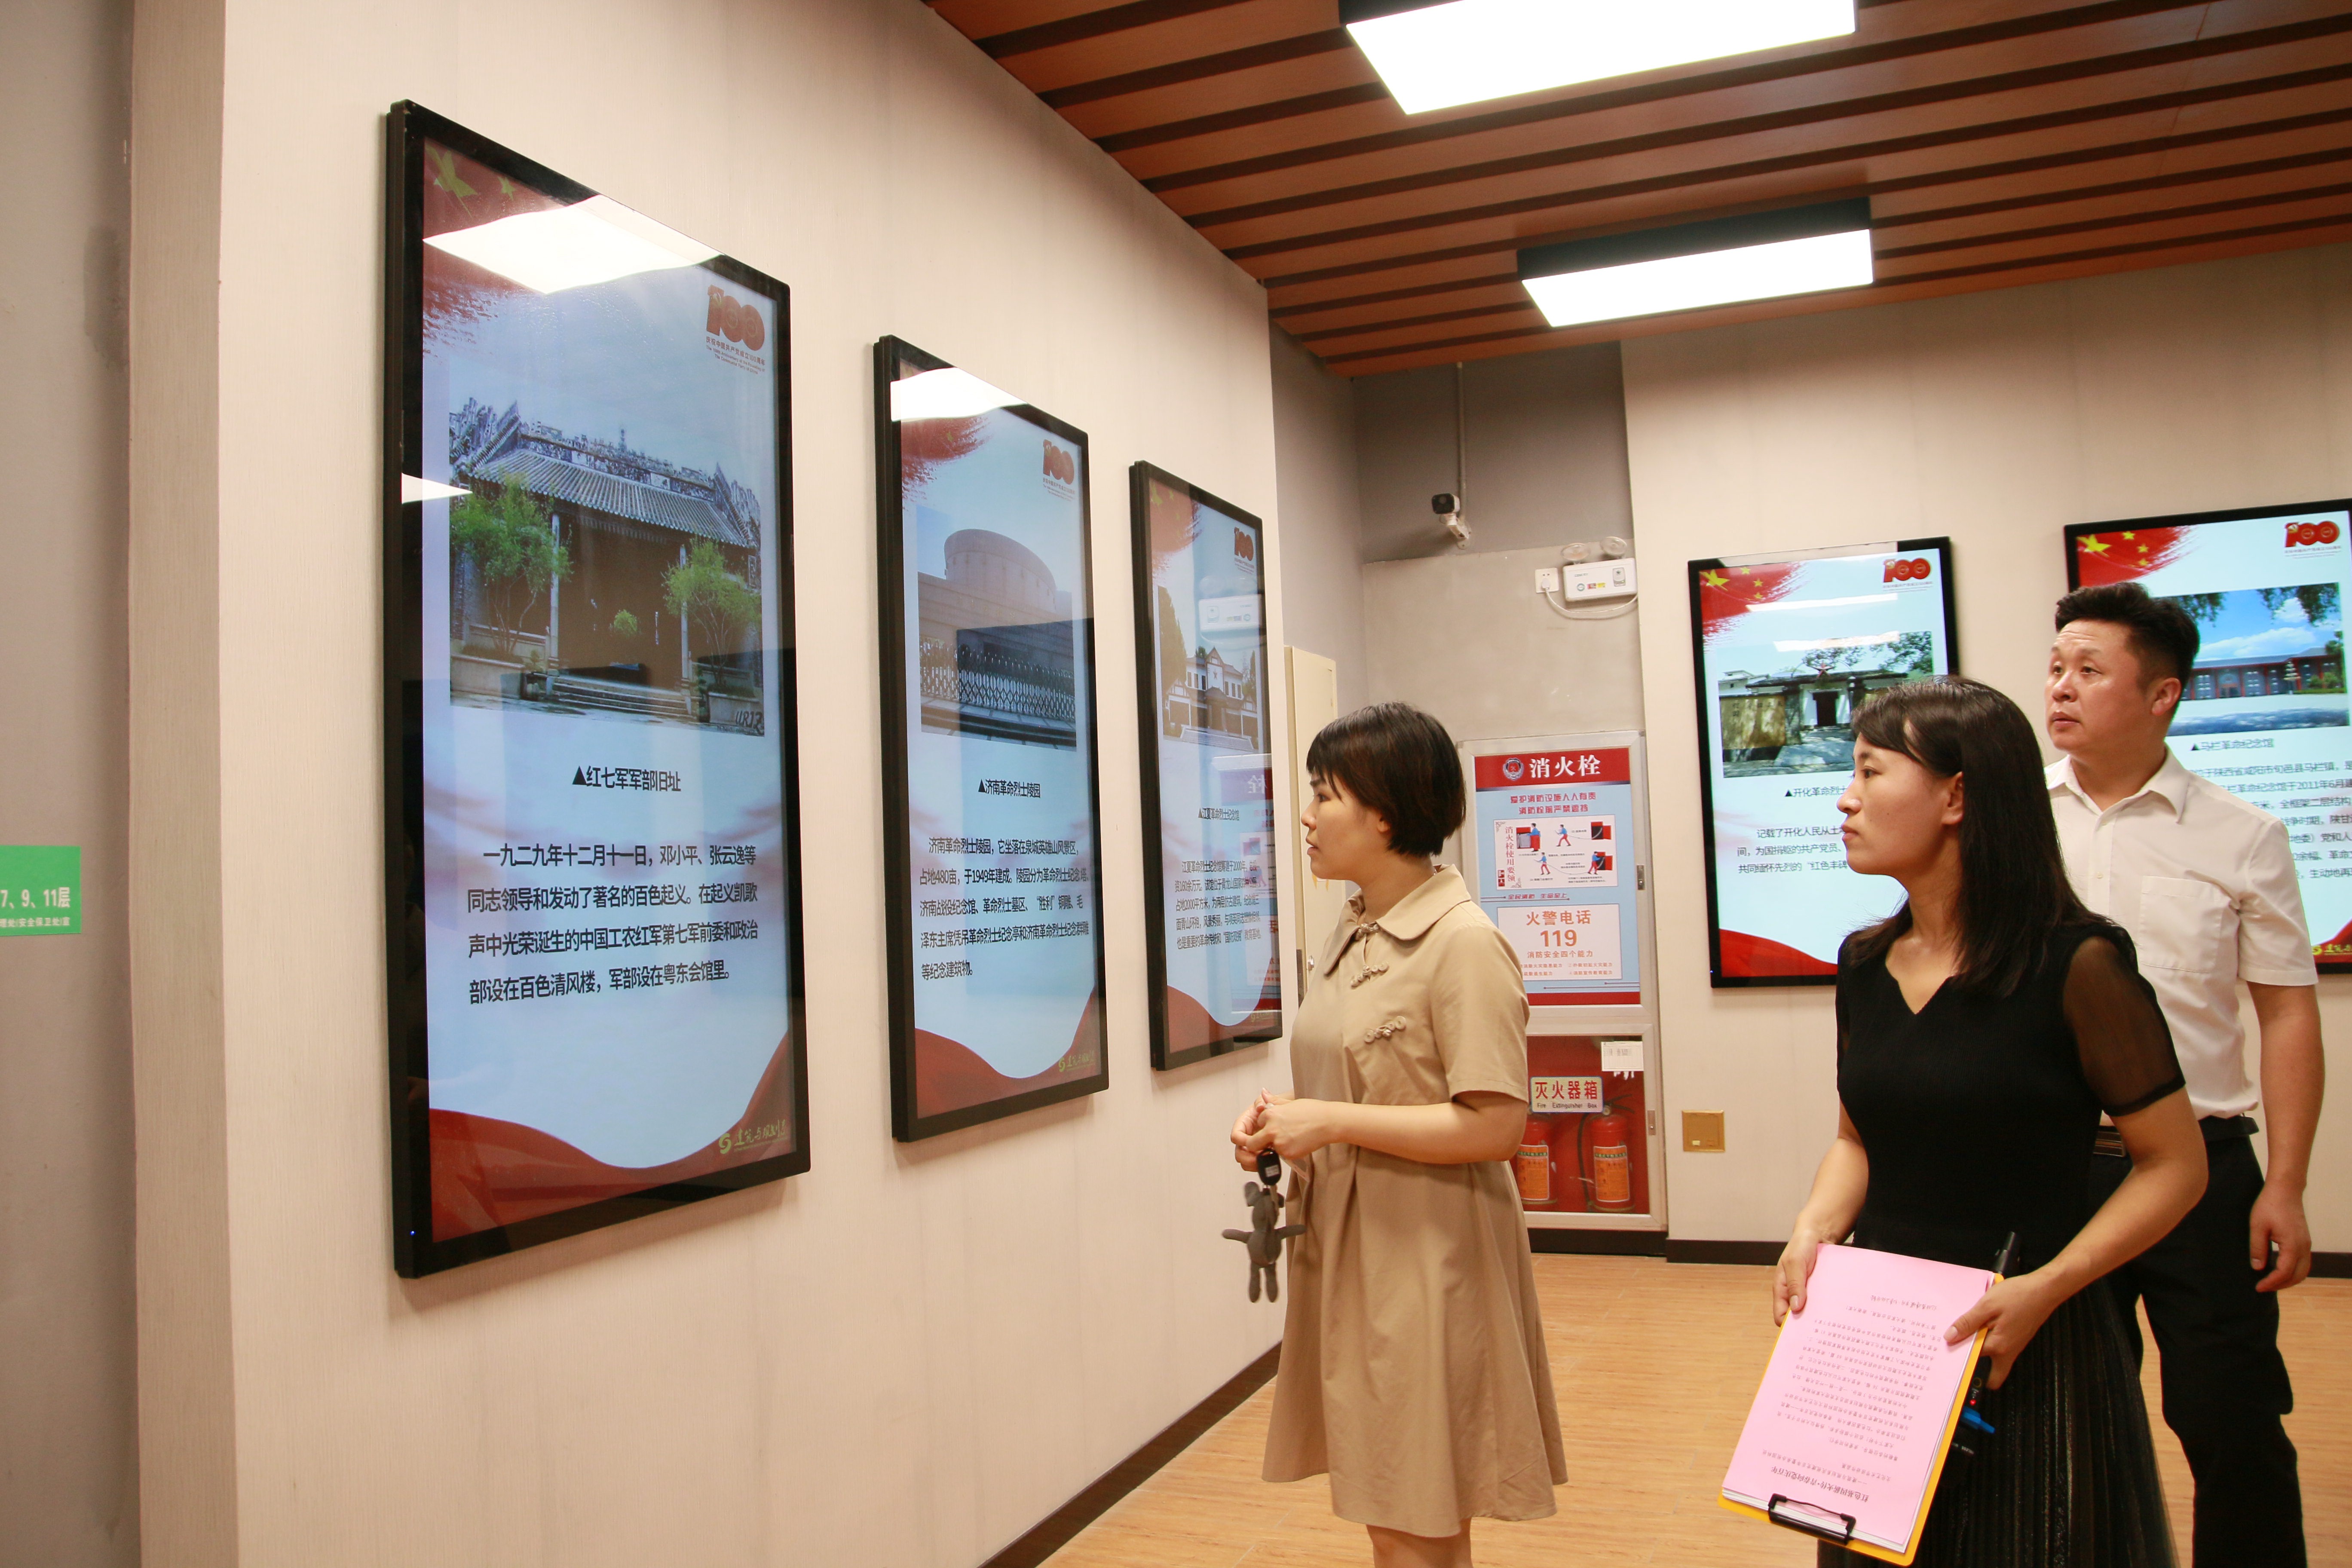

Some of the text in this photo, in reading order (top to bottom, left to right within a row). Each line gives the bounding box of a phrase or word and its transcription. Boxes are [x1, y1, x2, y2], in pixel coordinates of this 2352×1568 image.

[2201, 738, 2274, 751] 马栏革命纪念馆
[1529, 755, 1601, 778] 消火栓
[586, 766, 681, 792] 红七军军部旧址
[985, 779, 1041, 798] 济南革命烈士陵园
[2220, 778, 2352, 793] 栏革命纪念馆于2011年6月建
[1510, 792, 1596, 803] 爱护消防设施人人有责
[1519, 804, 1588, 815] 消防栓前严禁遮挡
[484, 843, 756, 867] 一九二九年十二月十一日,邓小平、张云逸等
[1505, 826, 1516, 882] 消火栓使用要领
[0, 887, 70, 908] 7、9、11层
[468, 882, 758, 913] 同志领导和发动了著名的百色起义。在起义凯歌
[1526, 910, 1591, 925] 火警电话
[469, 919, 758, 959] 声中光荣诞生的中国工农红军第七军前委和政治
[1540, 929, 1577, 947] 119
[1527, 950, 1593, 959] 消防安全四个能力
[921, 960, 973, 980] 等纪念建筑物。
[469, 959, 730, 1004] 部设在百色清风楼,军部设在粤东会馆里。
[1535, 1080, 1598, 1099] 灭火器箱
[1771, 1466, 1869, 1502] 红色基因薪火传·青春向党庆百年
